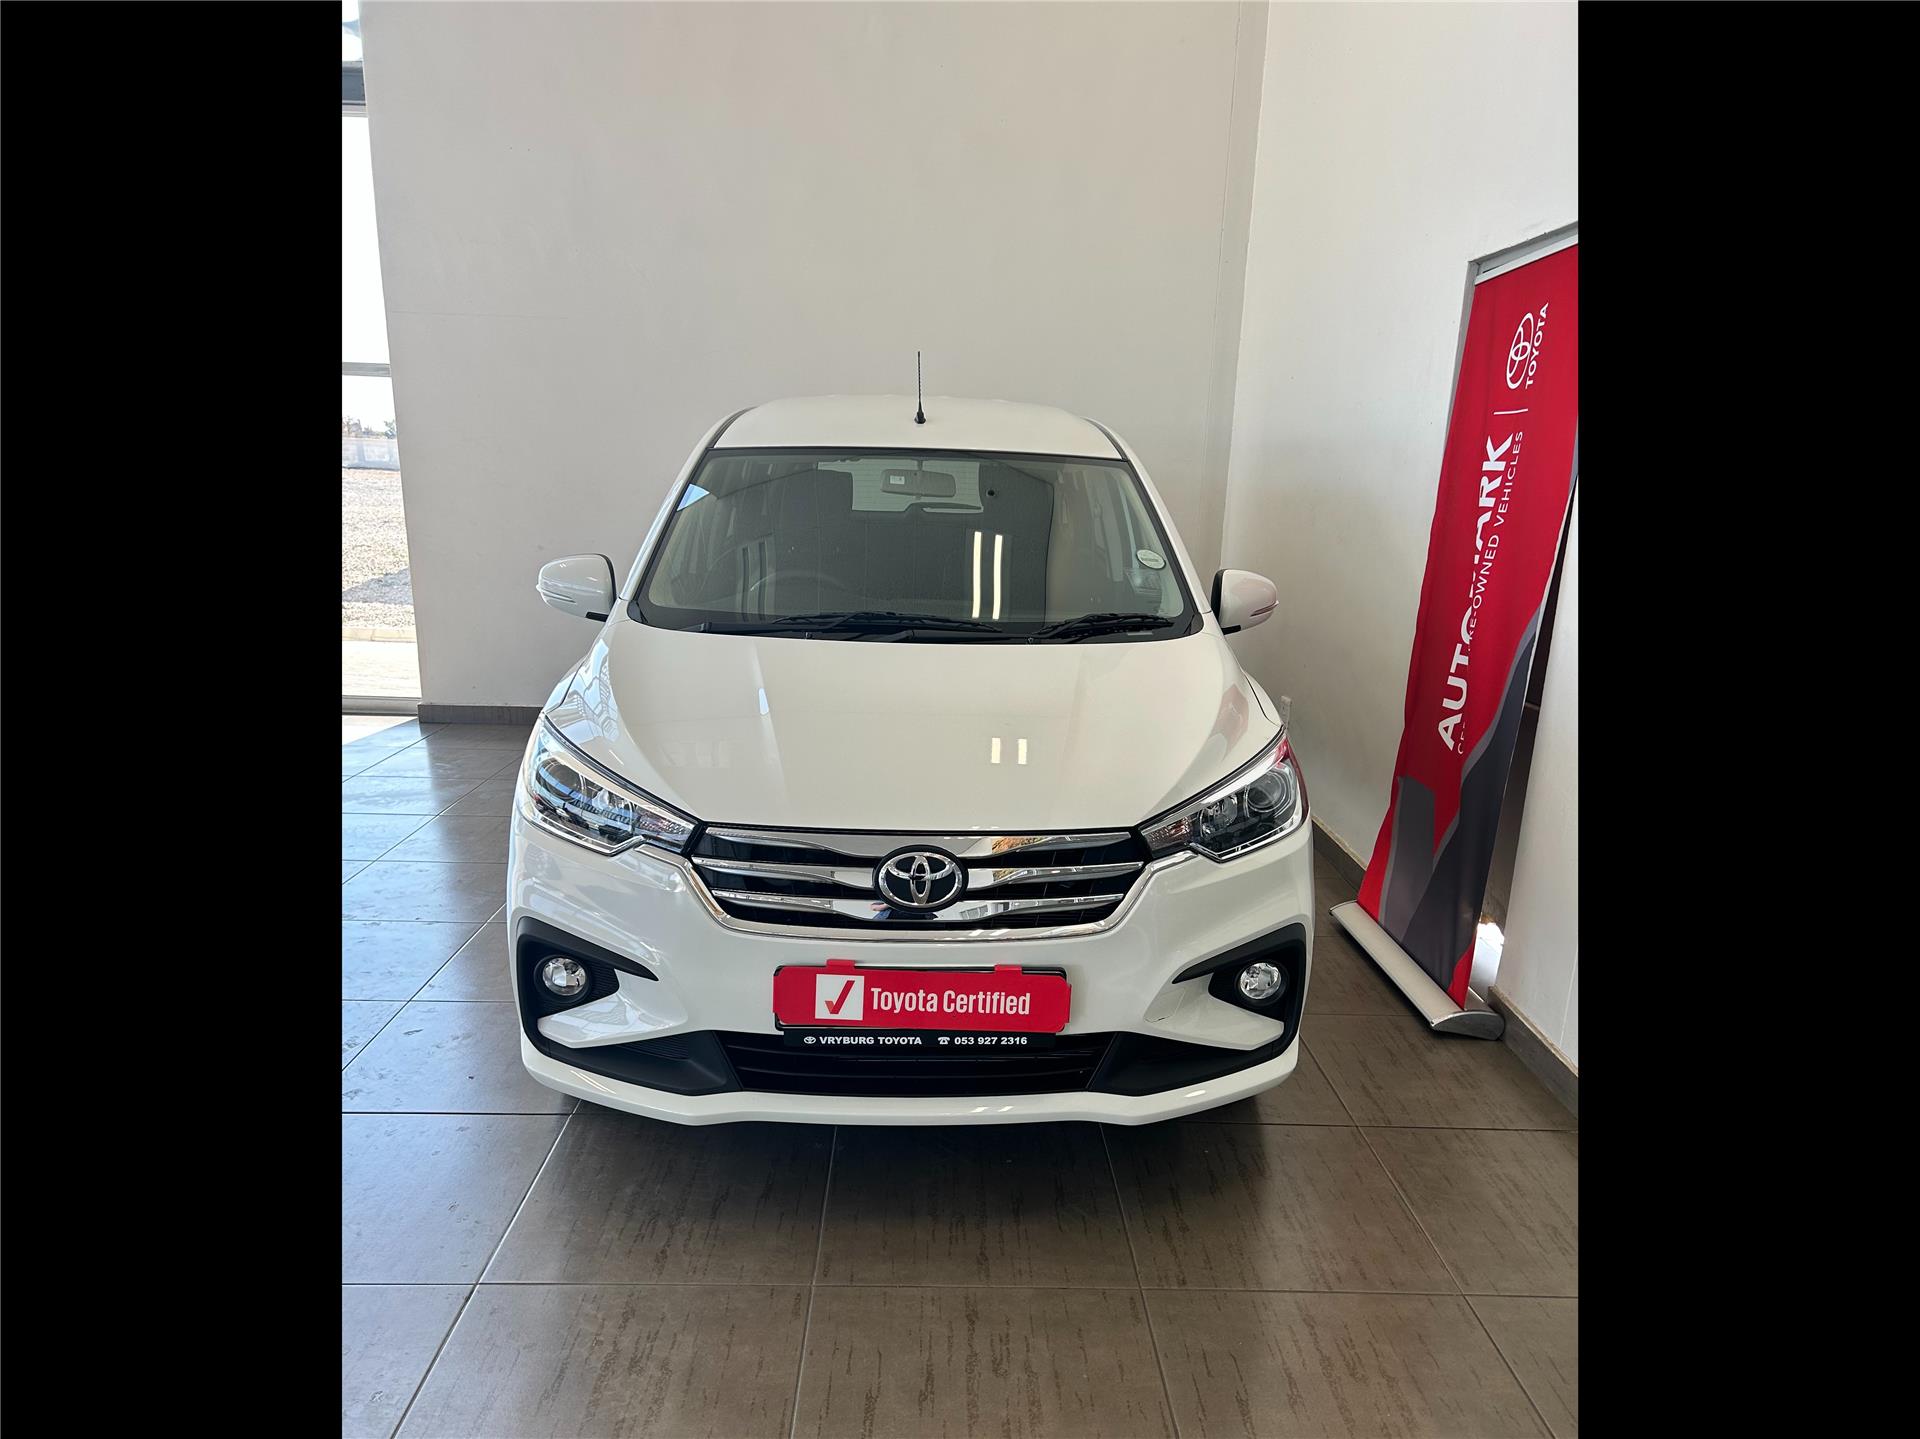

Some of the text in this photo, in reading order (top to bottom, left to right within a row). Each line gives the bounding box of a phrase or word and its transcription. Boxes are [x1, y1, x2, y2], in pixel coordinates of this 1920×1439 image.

[1525, 302, 1549, 389] TOYOTA
[1493, 431, 1523, 527] VEHICLES
[1438, 433, 1513, 751] AUTOARK
[819, 1036, 1028, 1045] VRYBURG TOYOTA 053 927 2316
[870, 987, 1031, 1015] Toyota Certified
